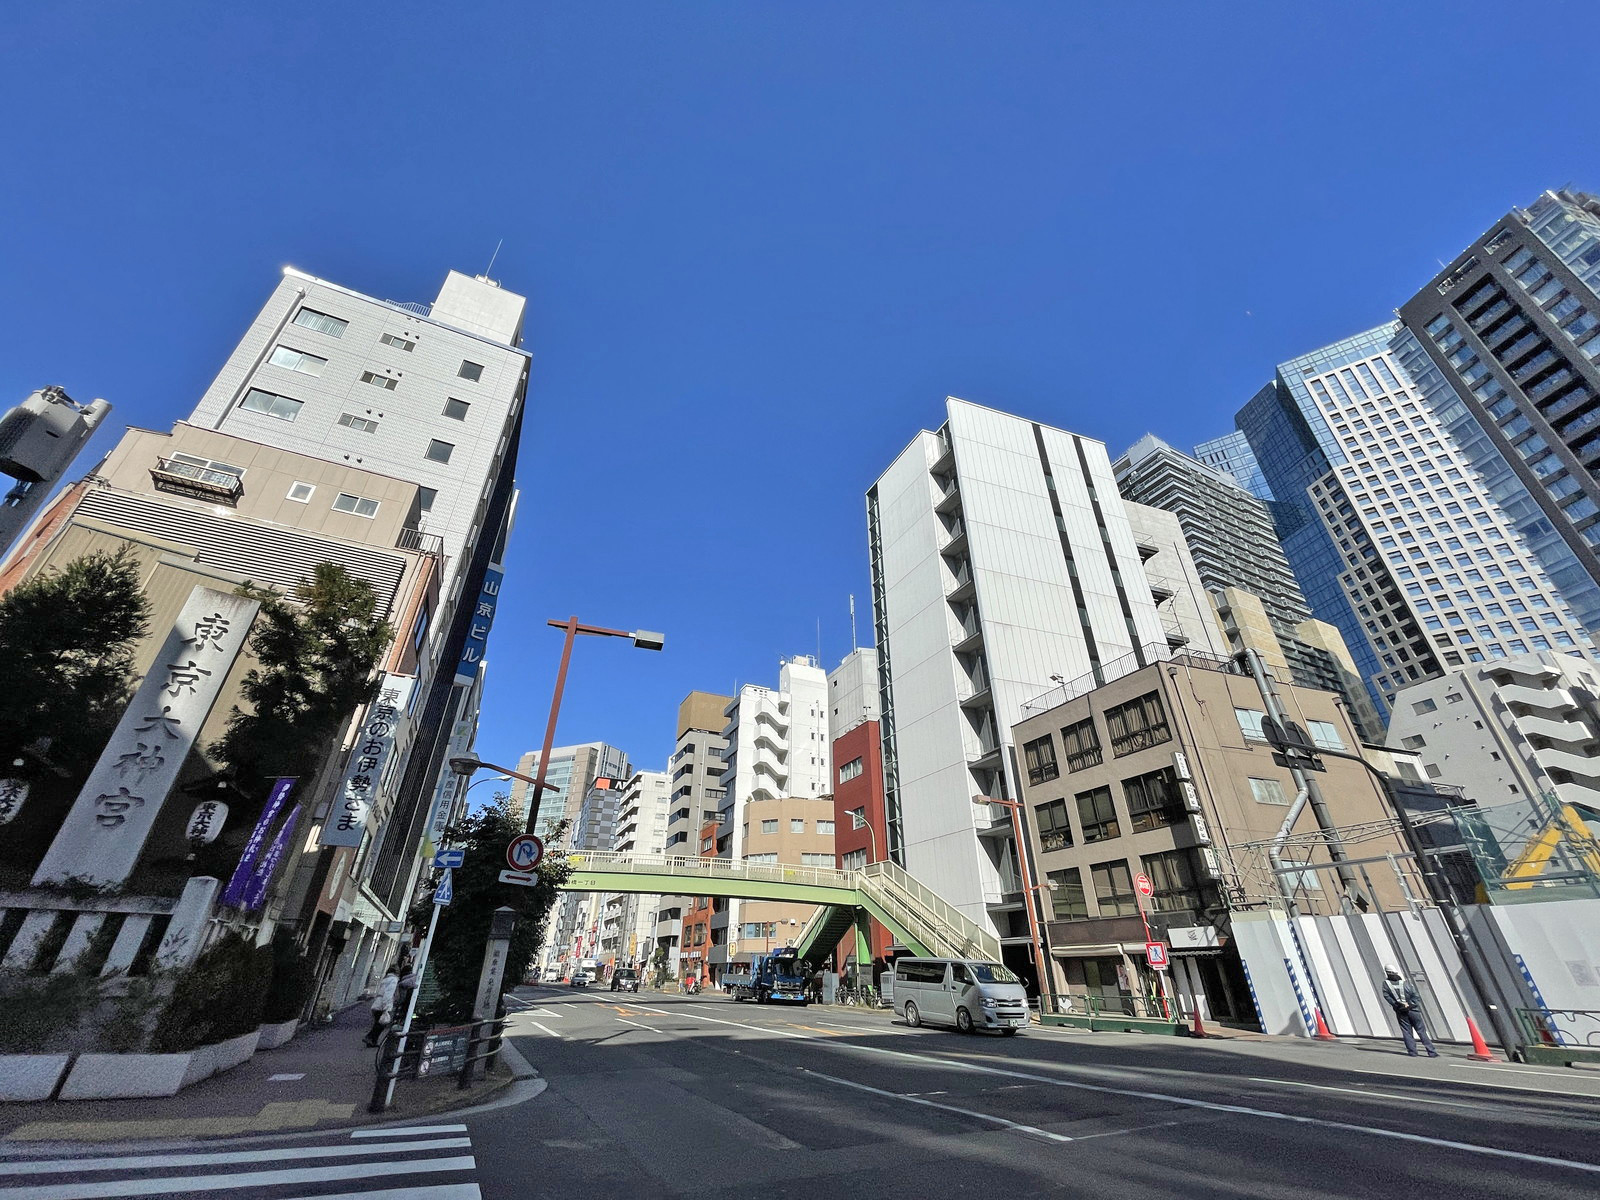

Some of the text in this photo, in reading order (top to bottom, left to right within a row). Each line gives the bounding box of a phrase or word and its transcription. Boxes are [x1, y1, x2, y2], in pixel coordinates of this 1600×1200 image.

[462, 580, 499, 663] 山京ビル
[94, 612, 230, 828] 東京大神宮
[336, 687, 402, 831] 東京のお伊勢さま
